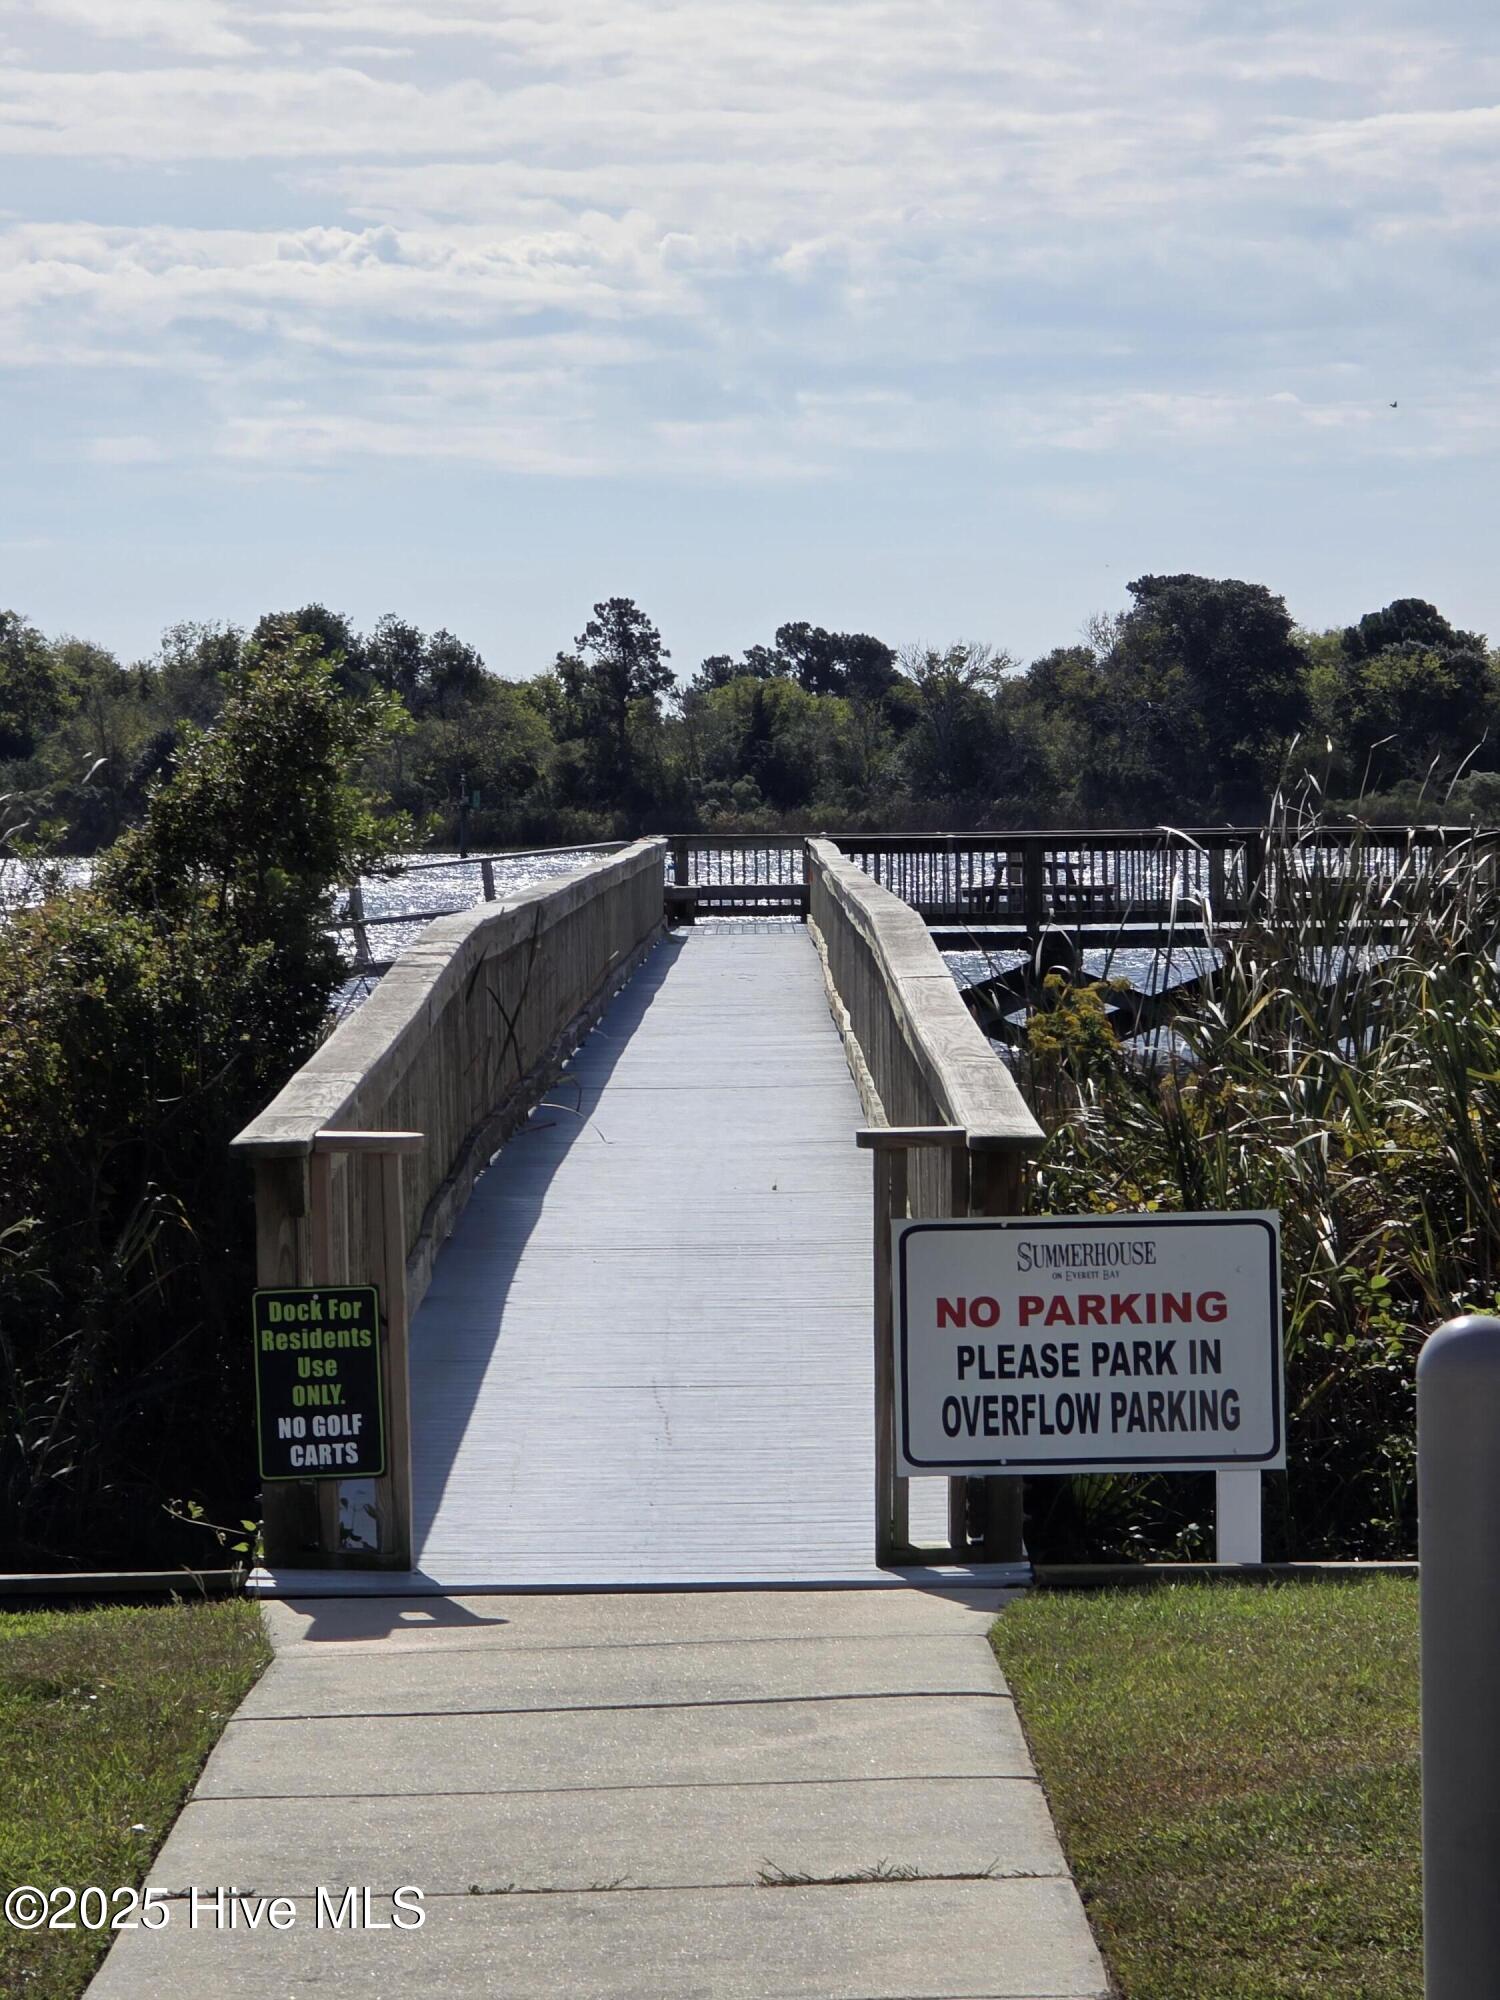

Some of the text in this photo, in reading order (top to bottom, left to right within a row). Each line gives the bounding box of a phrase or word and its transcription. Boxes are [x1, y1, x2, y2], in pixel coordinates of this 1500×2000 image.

[268, 1299, 362, 1322] Dock For
[936, 1291, 1228, 1328] NO PARKING
[261, 1328, 372, 1351] Residents
[297, 1357, 338, 1378] Use
[957, 1339, 1222, 1380] PLEASE PARK IN
[292, 1384, 346, 1406] ONLY.
[942, 1388, 1240, 1438] OVERFLOW PARKING
[278, 1414, 362, 1439] NO GOLF
[290, 1442, 359, 1467] CARTS
